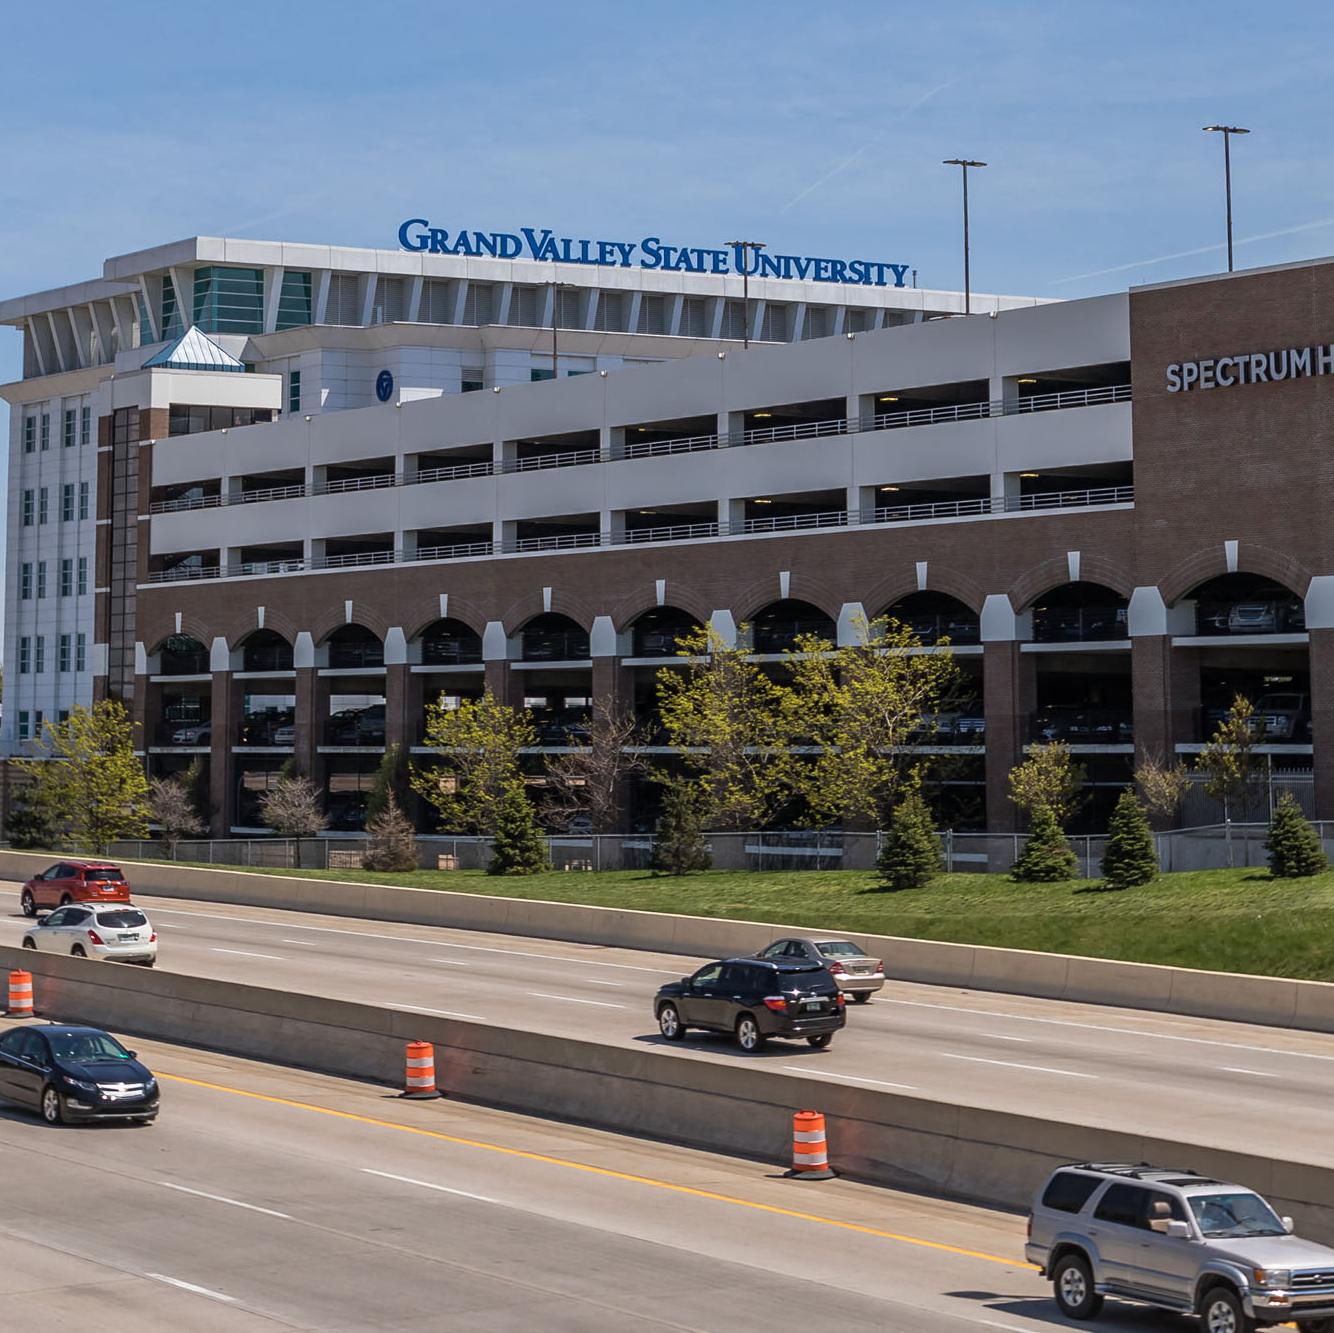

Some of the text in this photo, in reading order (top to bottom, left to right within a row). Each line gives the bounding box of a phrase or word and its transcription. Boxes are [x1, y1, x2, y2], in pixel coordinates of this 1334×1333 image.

[398, 218, 909, 287] GRAND VALLEY STATE UNIVERSITY
[1166, 347, 1313, 392] SPECTRUM
